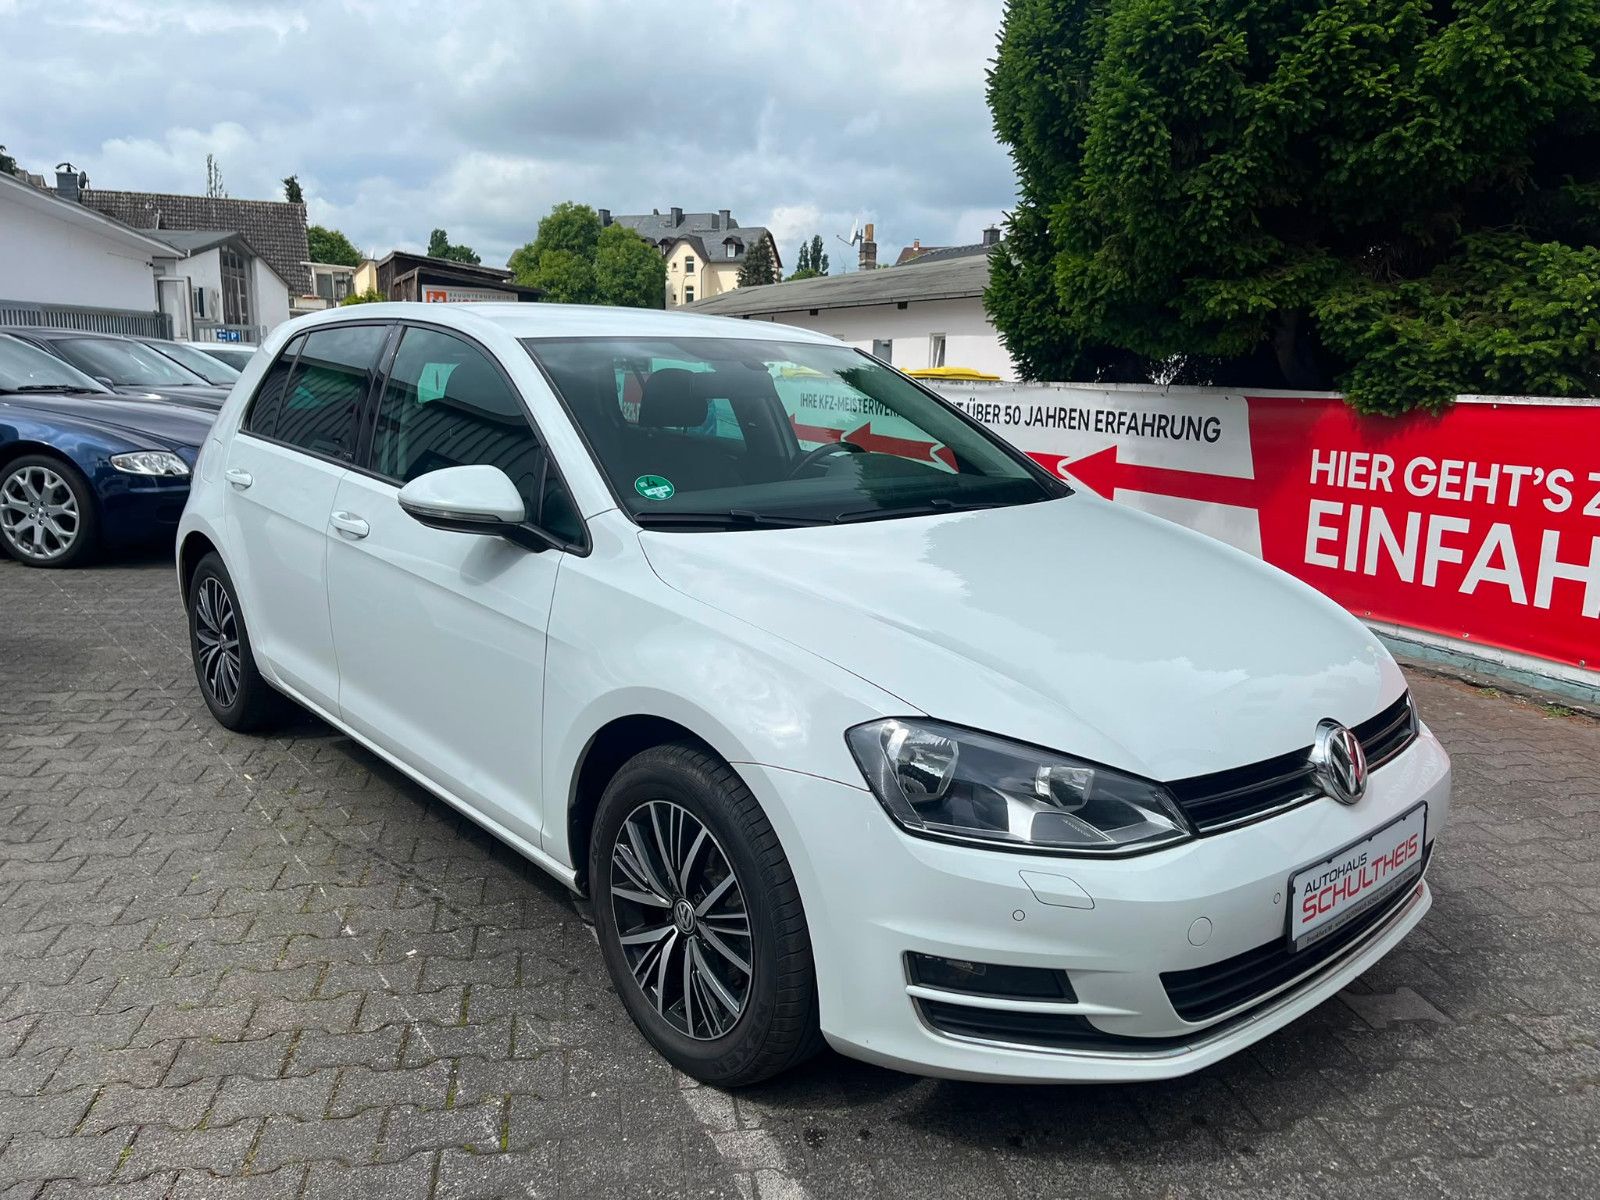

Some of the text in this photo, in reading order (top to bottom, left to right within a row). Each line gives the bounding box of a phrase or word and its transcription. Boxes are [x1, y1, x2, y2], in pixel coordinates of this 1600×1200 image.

[800, 392, 902, 418] IHRE KFZ-MEISTERWE
[1003, 404, 1021, 426] 50
[1024, 405, 1091, 432] JAHREN
[1094, 410, 1222, 444] ERFAHRUNG
[1309, 448, 1396, 493] HIER
[1304, 498, 1600, 620] EINFAH
[1302, 833, 1418, 924] SCHULTHEIS
[1303, 852, 1368, 897] AUTOHAUS
